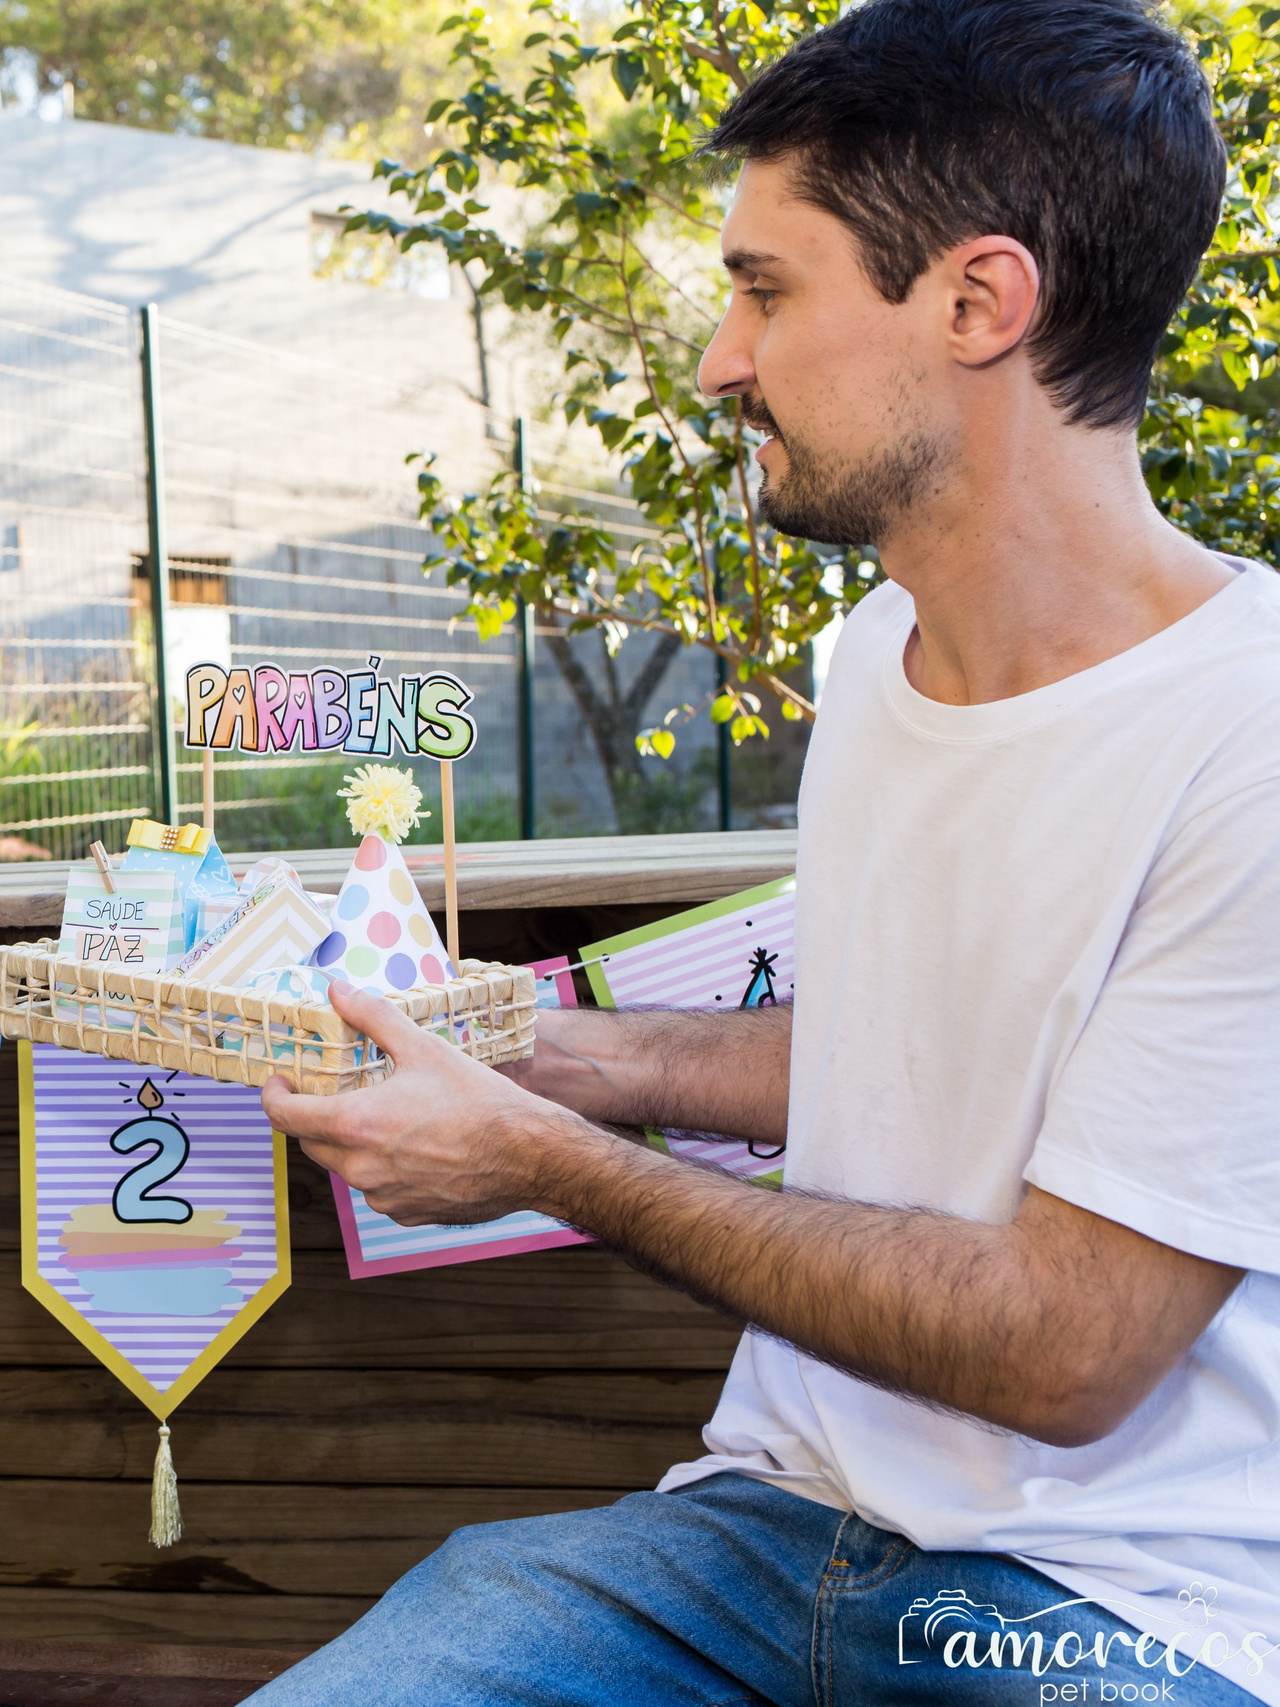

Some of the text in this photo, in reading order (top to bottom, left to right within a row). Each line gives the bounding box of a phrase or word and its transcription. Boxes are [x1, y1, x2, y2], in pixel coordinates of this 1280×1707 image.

[186, 655, 472, 759] PARABÉNS
[86, 896, 145, 922] SAÚDE
[82, 933, 144, 963] PAZ
[109, 1116, 193, 1225] 2
